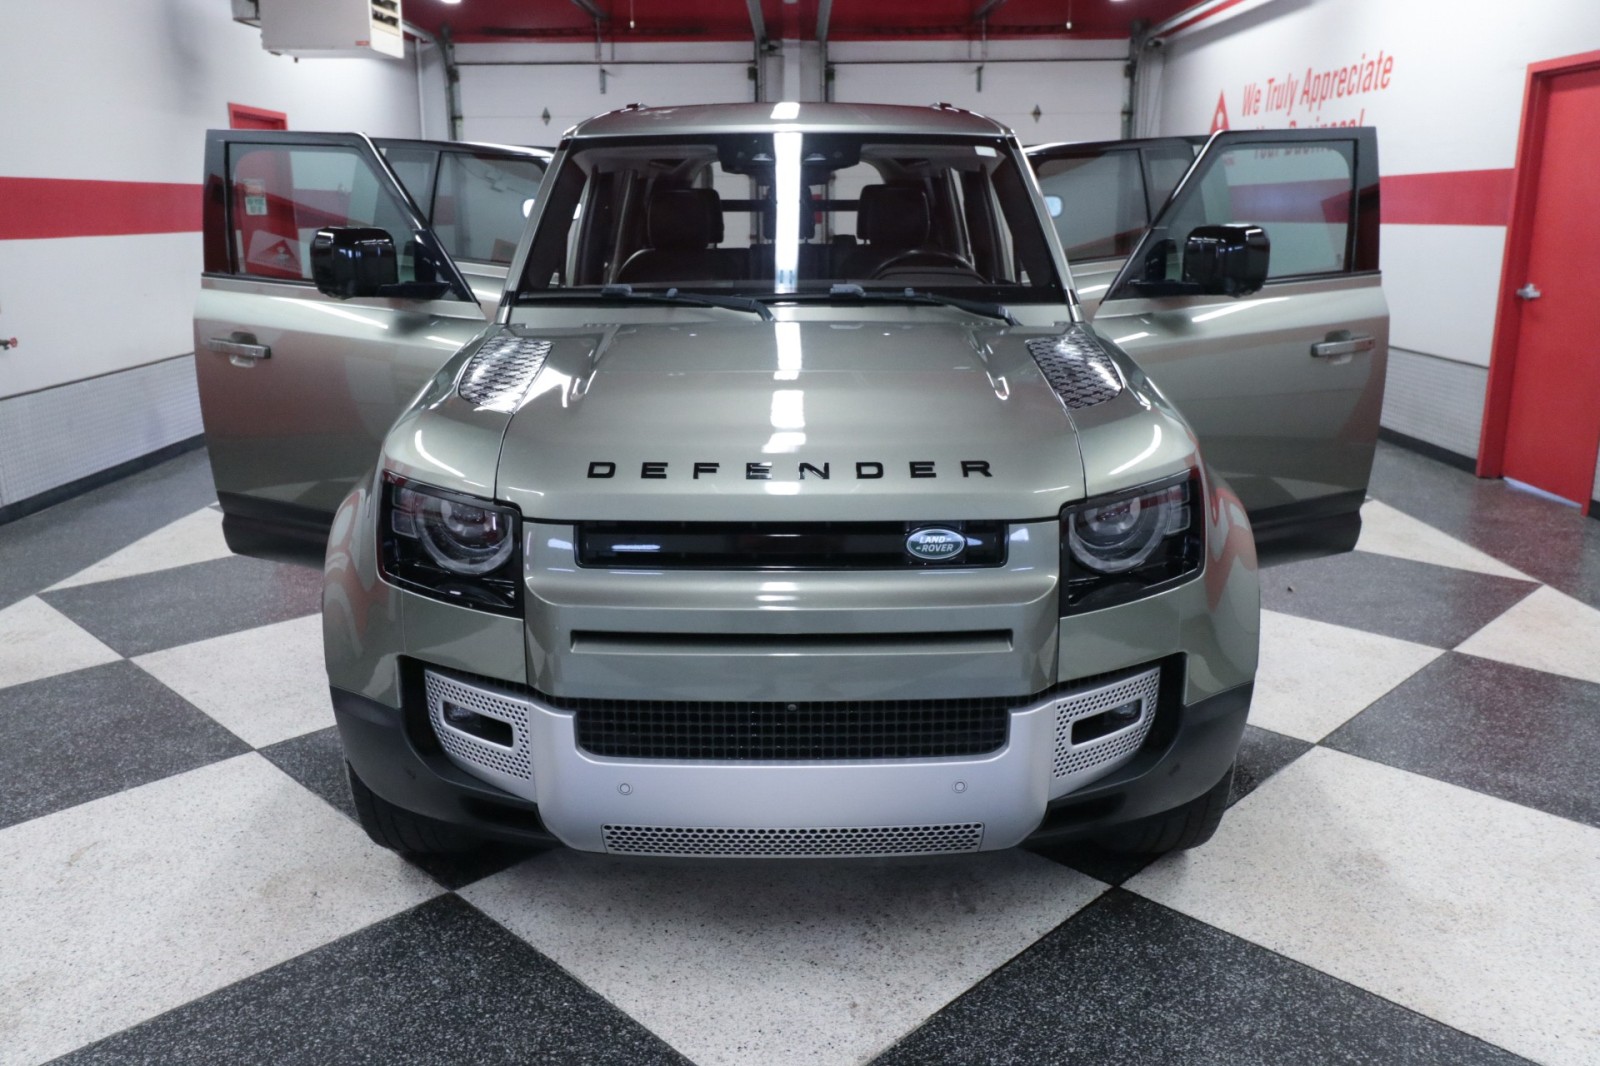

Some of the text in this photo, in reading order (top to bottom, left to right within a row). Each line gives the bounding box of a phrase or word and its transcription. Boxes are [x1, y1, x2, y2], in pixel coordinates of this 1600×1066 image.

[1242, 50, 1394, 117] We Truly Appreciate
[587, 460, 993, 480] DEFENDER
